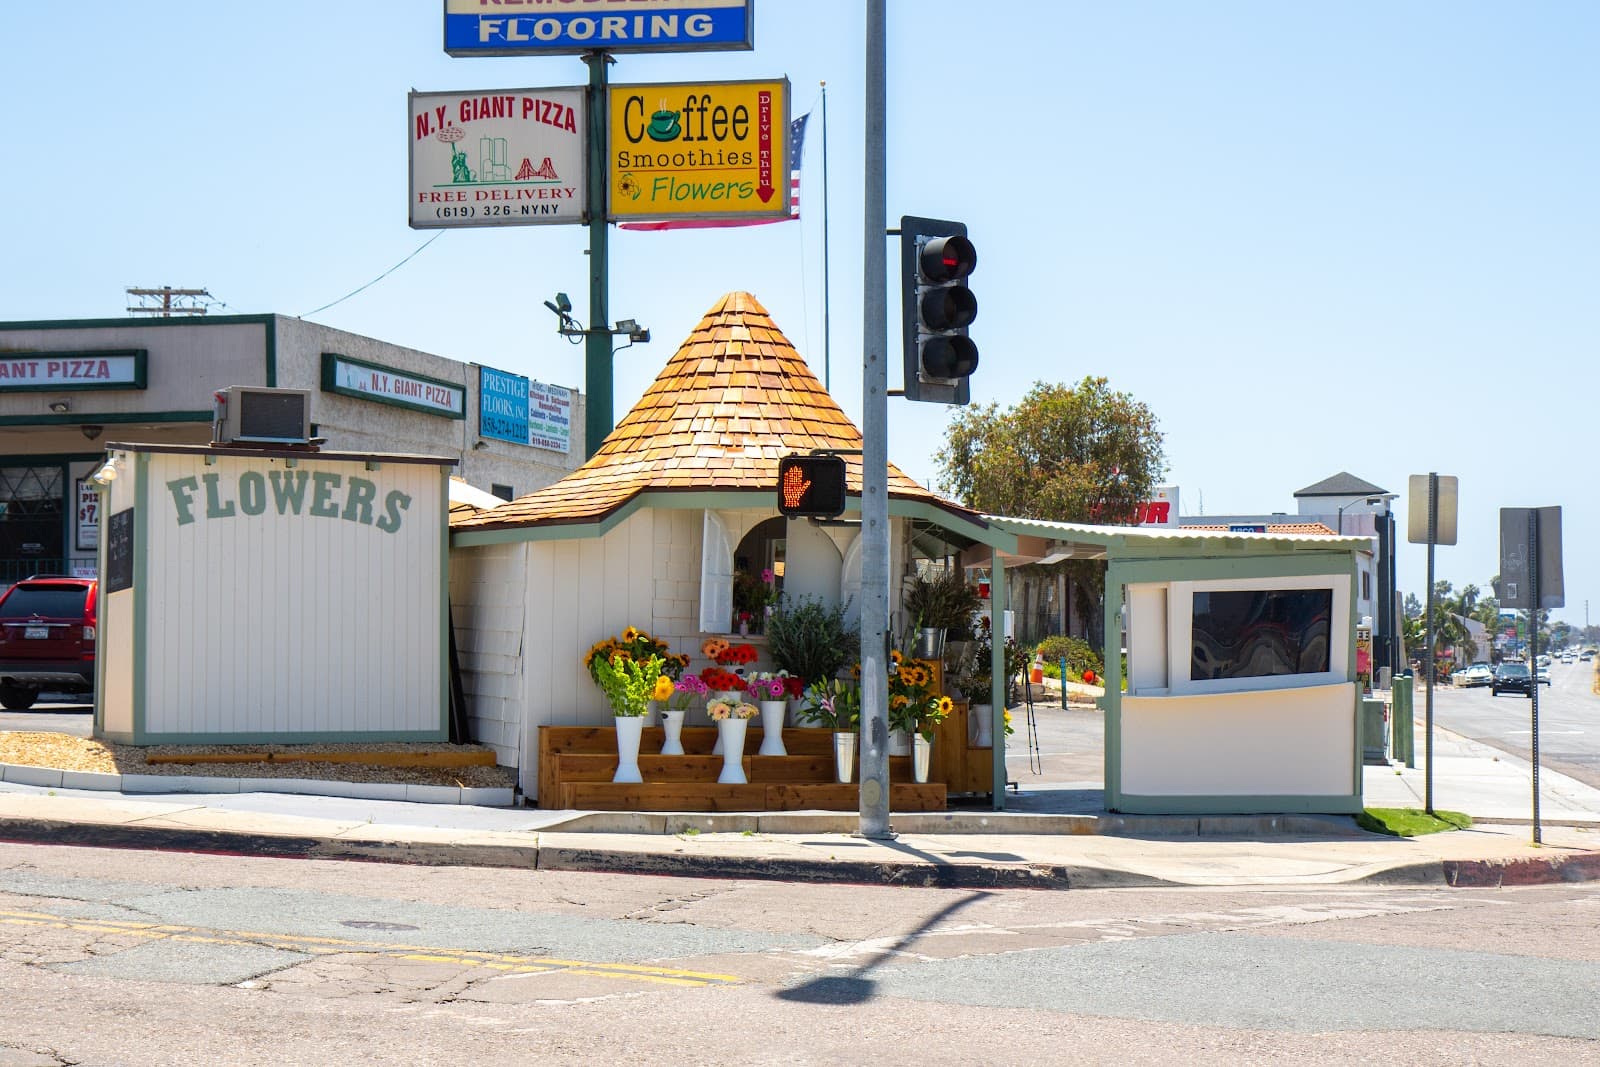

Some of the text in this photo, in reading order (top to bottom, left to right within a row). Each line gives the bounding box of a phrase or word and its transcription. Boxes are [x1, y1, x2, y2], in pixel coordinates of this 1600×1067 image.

[479, 14, 713, 42] FLOORING
[416, 96, 577, 140] N.Y. GIANT PIZZA
[760, 95, 770, 186] Drive Thru
[618, 149, 753, 169] Smoothies
[418, 187, 577, 203] FREE DELIVERY
[651, 175, 754, 201] Flowers
[436, 204, 560, 218] (619) 326-NYNY
[47, 360, 110, 379] PIZZA
[371, 373, 452, 408] N.Y. GIANT PIZZA
[483, 372, 526, 399] PRESTIGE
[166, 470, 412, 534] FLOWERS
